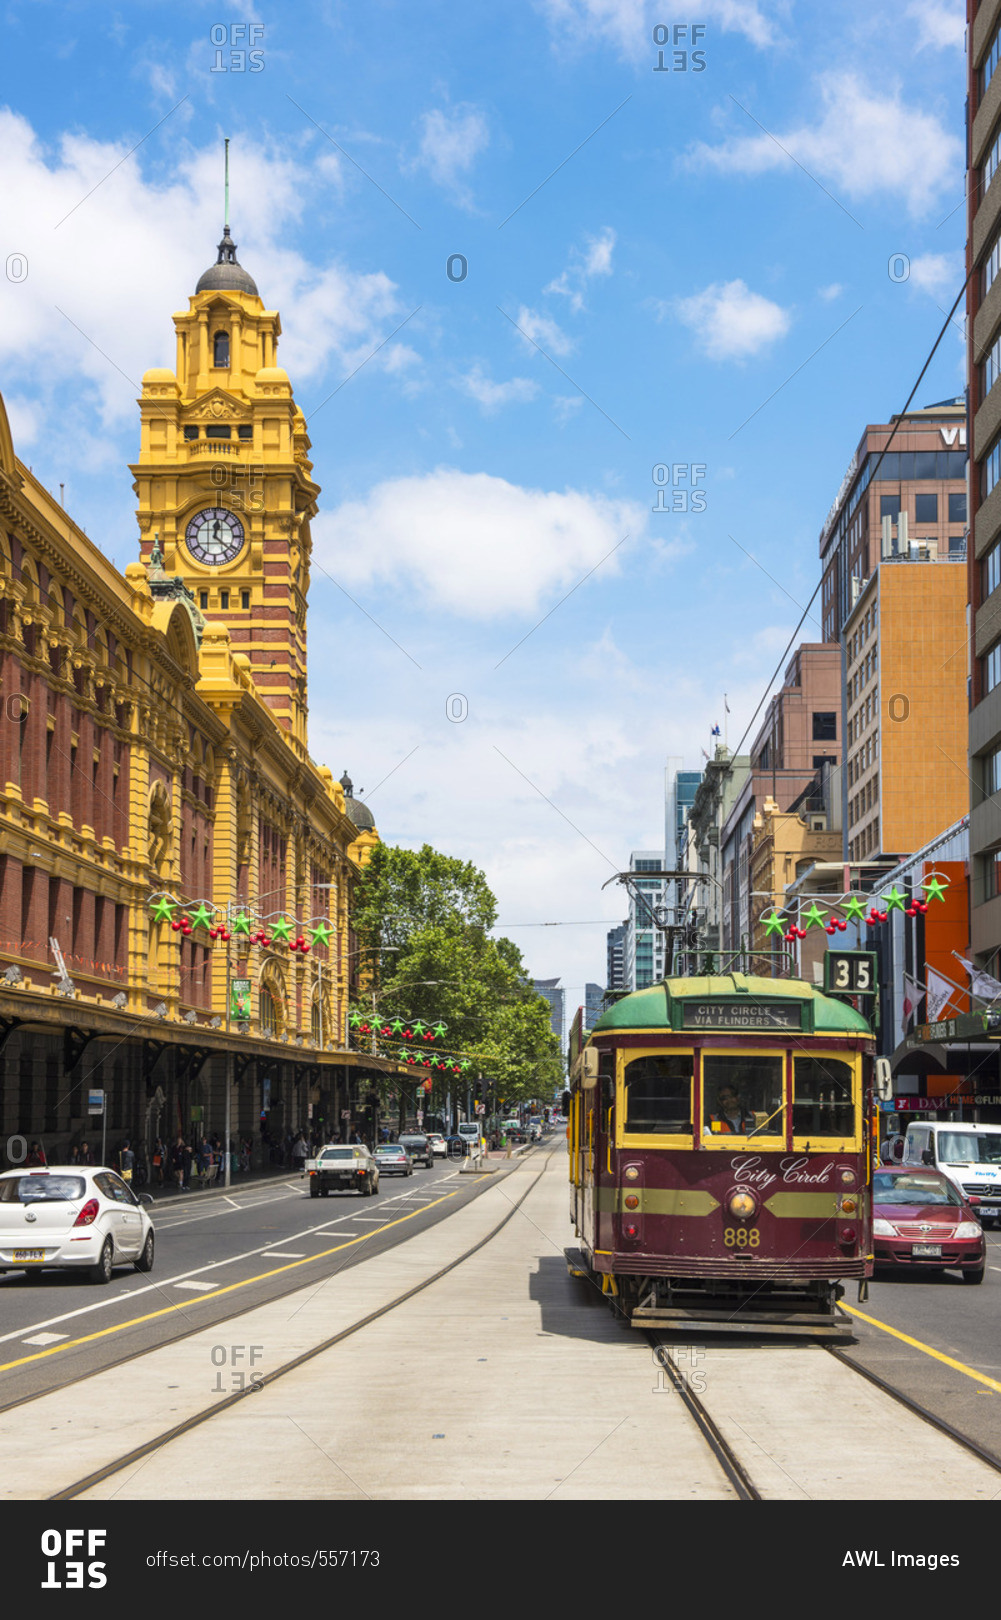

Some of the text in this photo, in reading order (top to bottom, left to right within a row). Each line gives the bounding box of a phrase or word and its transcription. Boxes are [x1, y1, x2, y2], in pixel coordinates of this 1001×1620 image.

[836, 960, 869, 988] 35
[698, 1006, 724, 1015] CITY
[731, 1006, 771, 1015] CIRCLE
[695, 1016, 790, 1026] VIA FLINDERS ST
[731, 1156, 834, 1190] City Circle
[724, 1228, 760, 1247] 888
